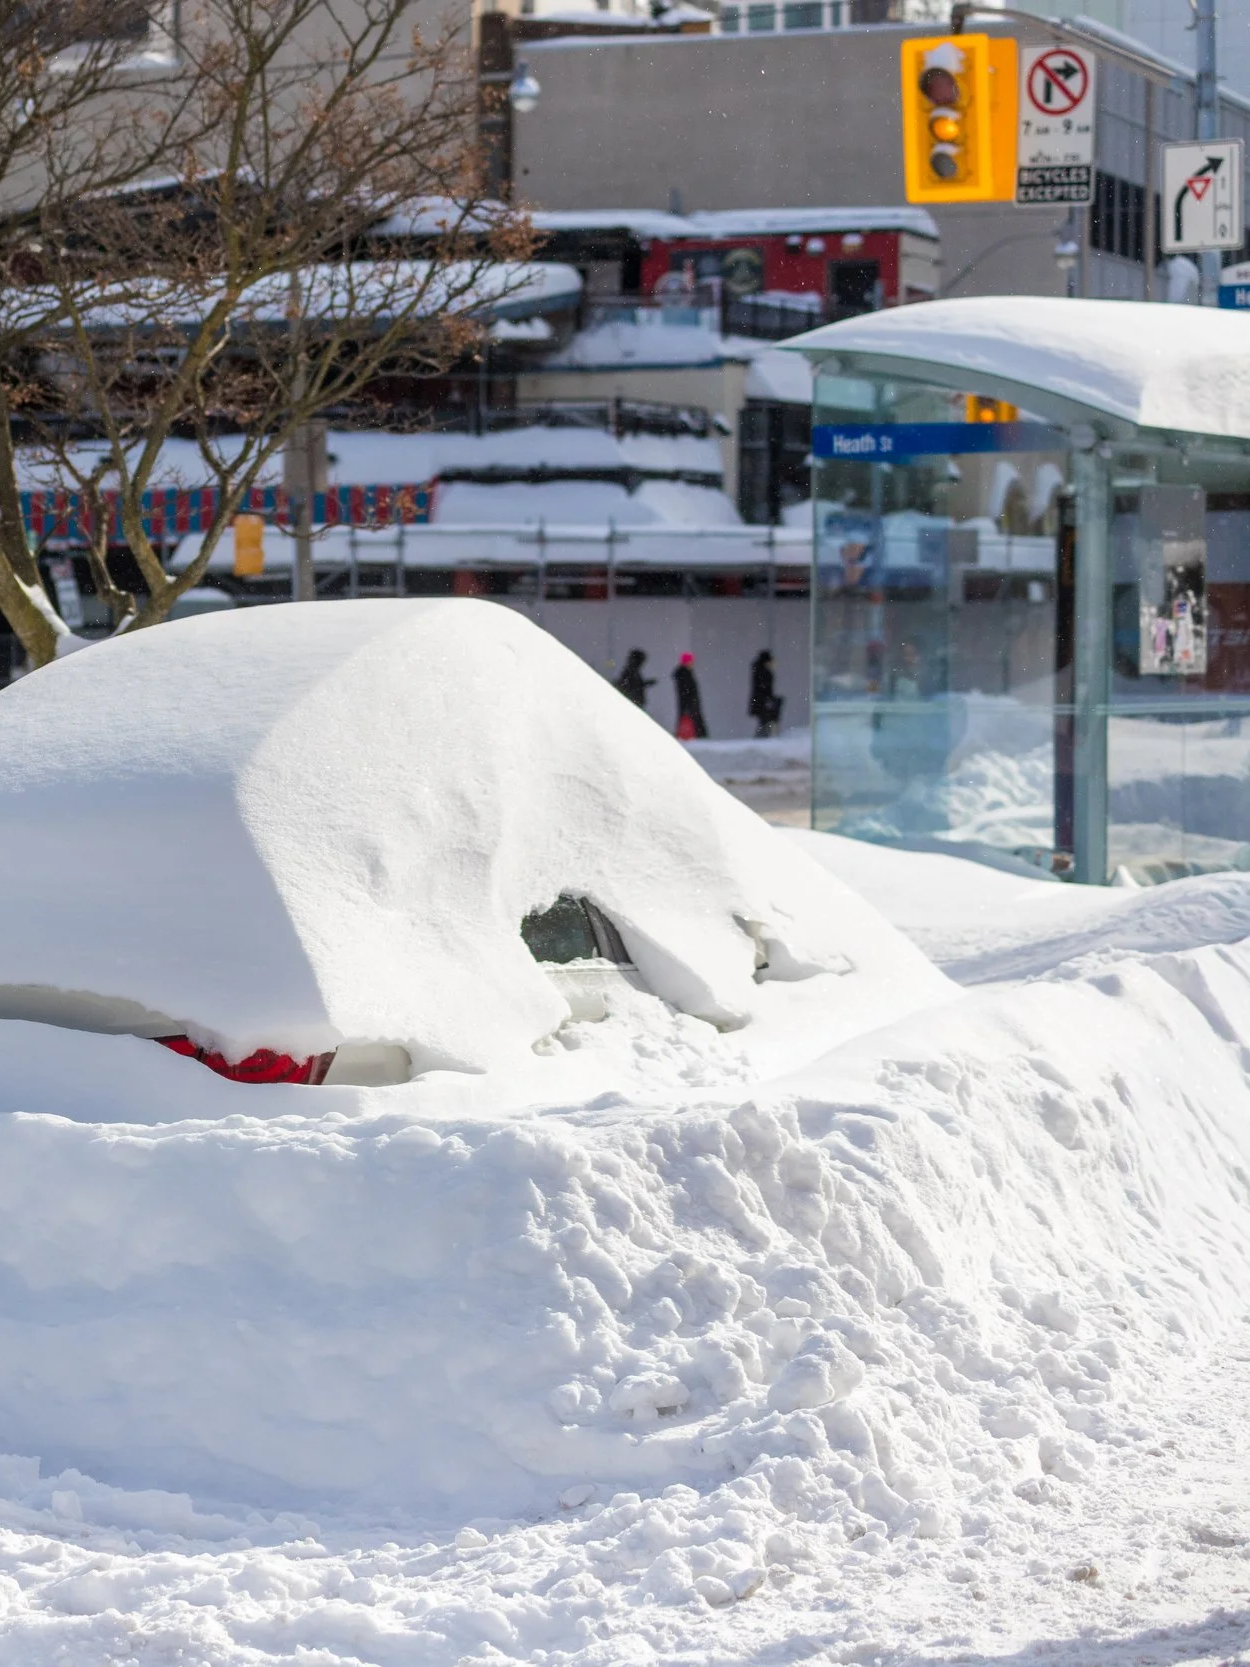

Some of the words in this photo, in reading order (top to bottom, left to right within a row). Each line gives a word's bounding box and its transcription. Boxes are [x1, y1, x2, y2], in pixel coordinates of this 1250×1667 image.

[1020, 168, 1088, 184] BICYCLES
[1019, 185, 1089, 200] EXCEPTED
[832, 433, 876, 454] Heath
